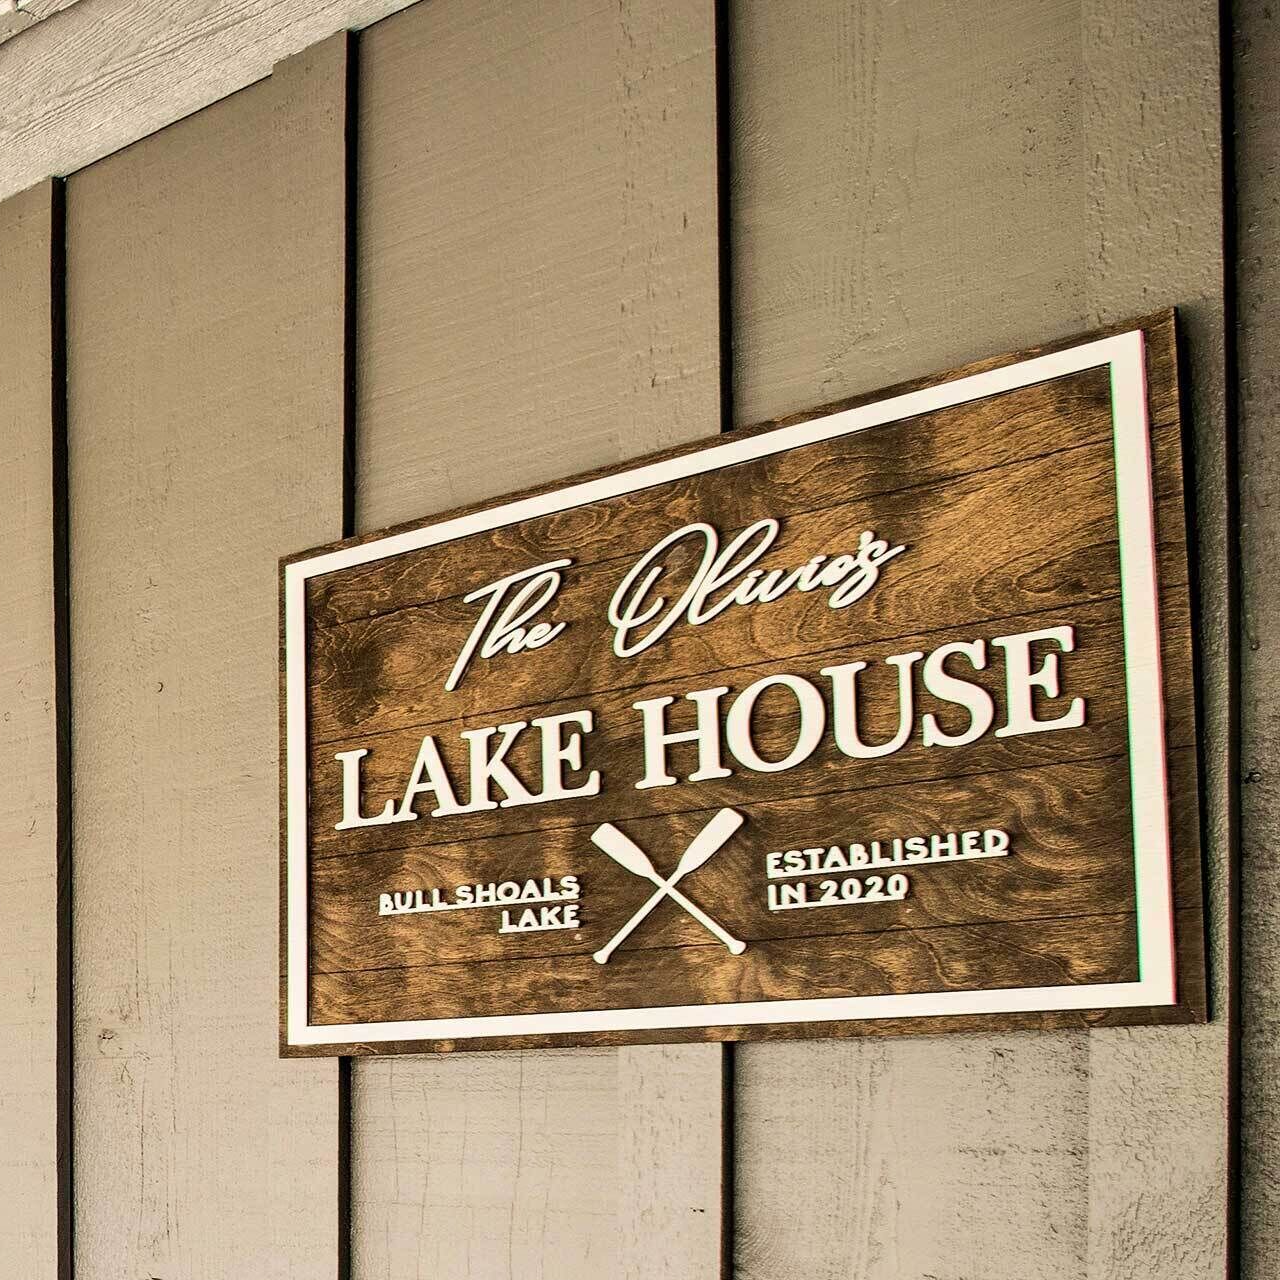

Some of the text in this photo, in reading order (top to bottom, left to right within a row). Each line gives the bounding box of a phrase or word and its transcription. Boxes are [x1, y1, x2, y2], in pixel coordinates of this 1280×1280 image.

[444, 558, 571, 692] The
[334, 625, 1085, 831] LAKE HOUSE
[766, 829, 1009, 879] ESTABLISHED
[378, 875, 580, 916] BULL SHOALS
[767, 873, 909, 911] IN 2020
[498, 904, 580, 934] LAKE
